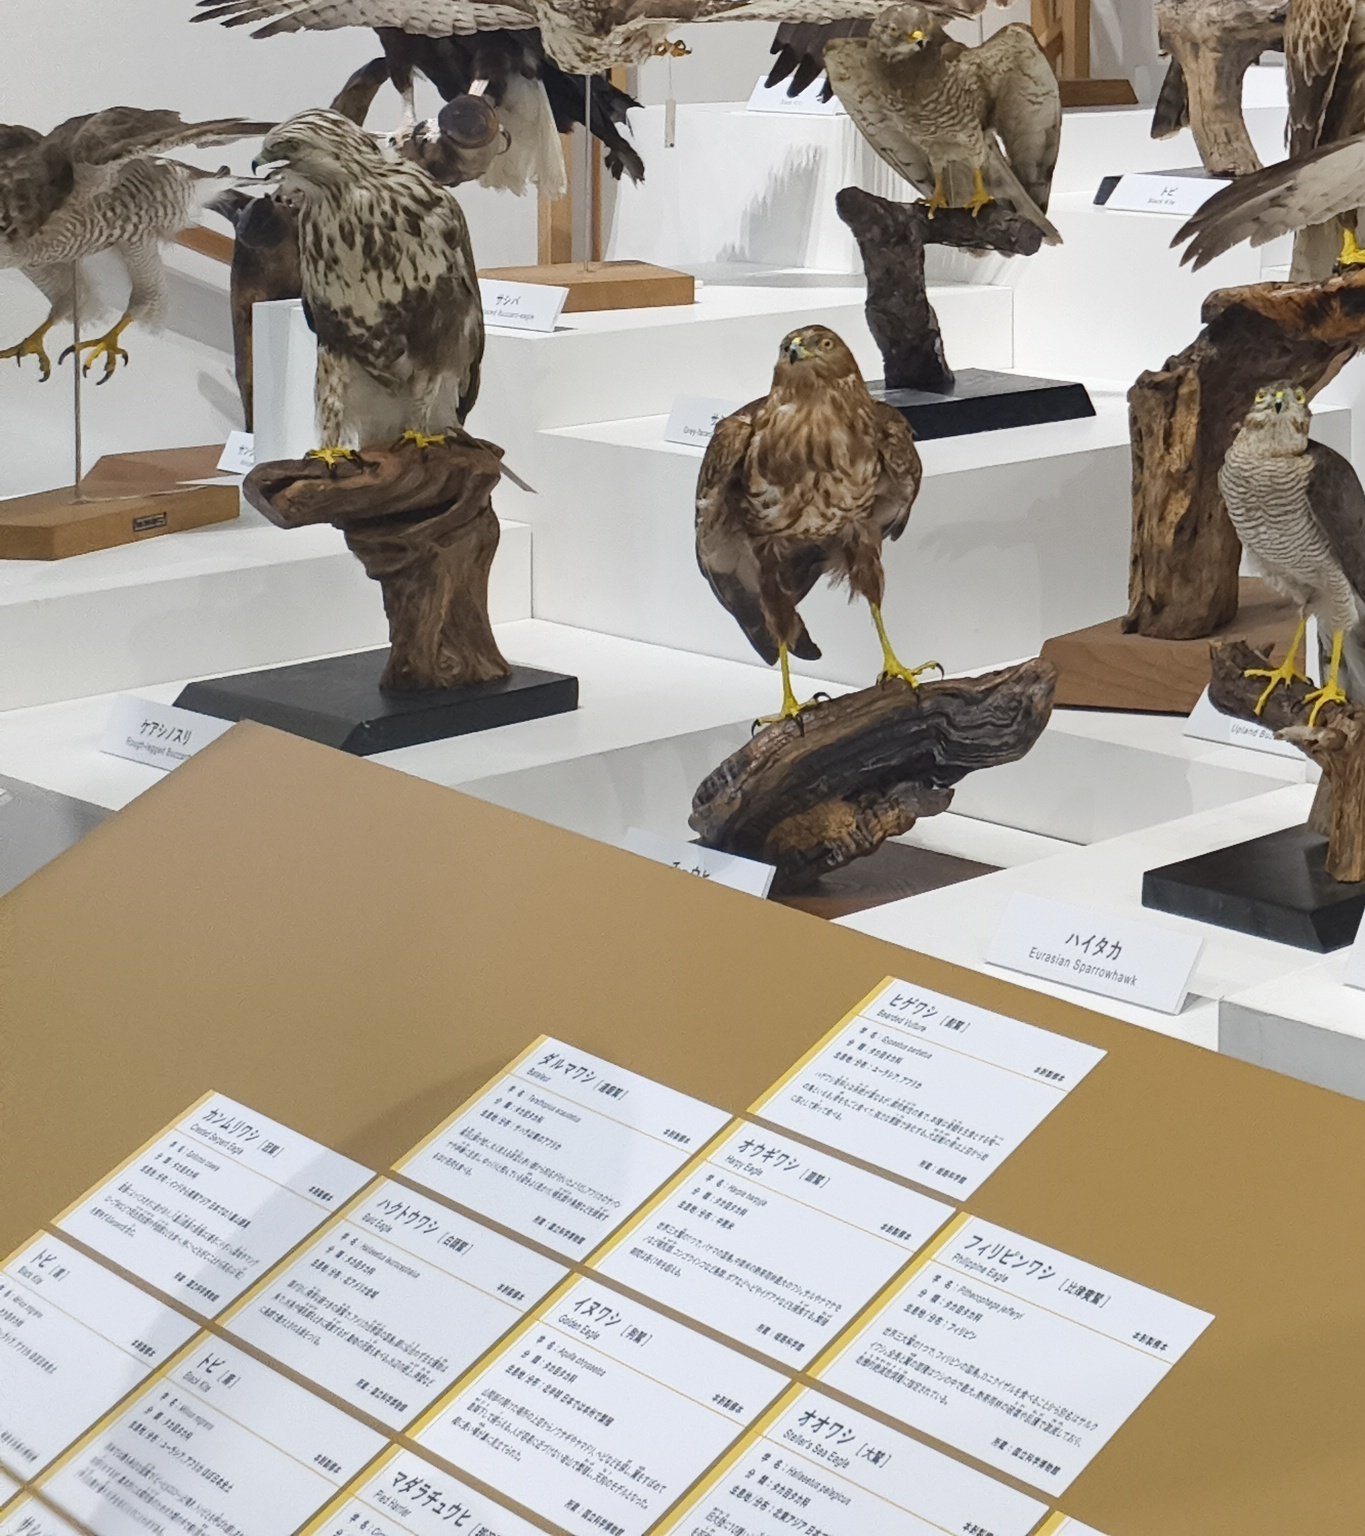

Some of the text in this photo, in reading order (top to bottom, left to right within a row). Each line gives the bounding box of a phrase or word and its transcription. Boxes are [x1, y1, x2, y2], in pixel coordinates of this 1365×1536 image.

[140, 719, 192, 746] ケアシノスリ
[1065, 933, 1122, 961] ハイタカ
[1029, 947, 1138, 986] Eurasian Sparrowhawk
[889, 994, 938, 1018] ヒゲワシ
[538, 1053, 596, 1082] ダルマワシ
[202, 1109, 260, 1141] カンムリワシ
[725, 1155, 763, 1176] Harpy Eagle
[738, 1139, 799, 1171] オウギワシ
[377, 1200, 439, 1234] ハクトウワシ
[30, 1249, 57, 1268] トビ
[952, 1253, 1008, 1283] Philippine Eagle
[964, 1235, 1055, 1280] フィリピンワシ
[574, 1298, 621, 1326] イヌワシ
[558, 1314, 600, 1340] Golden Eagle
[197, 1353, 225, 1373] トビ
[798, 1410, 855, 1444] オオワシ
[783, 1429, 850, 1469] Steller's Sea Eagle
[373, 1490, 392, 1504] Pied
[393, 1472, 471, 1527] マダラチュウヒ
